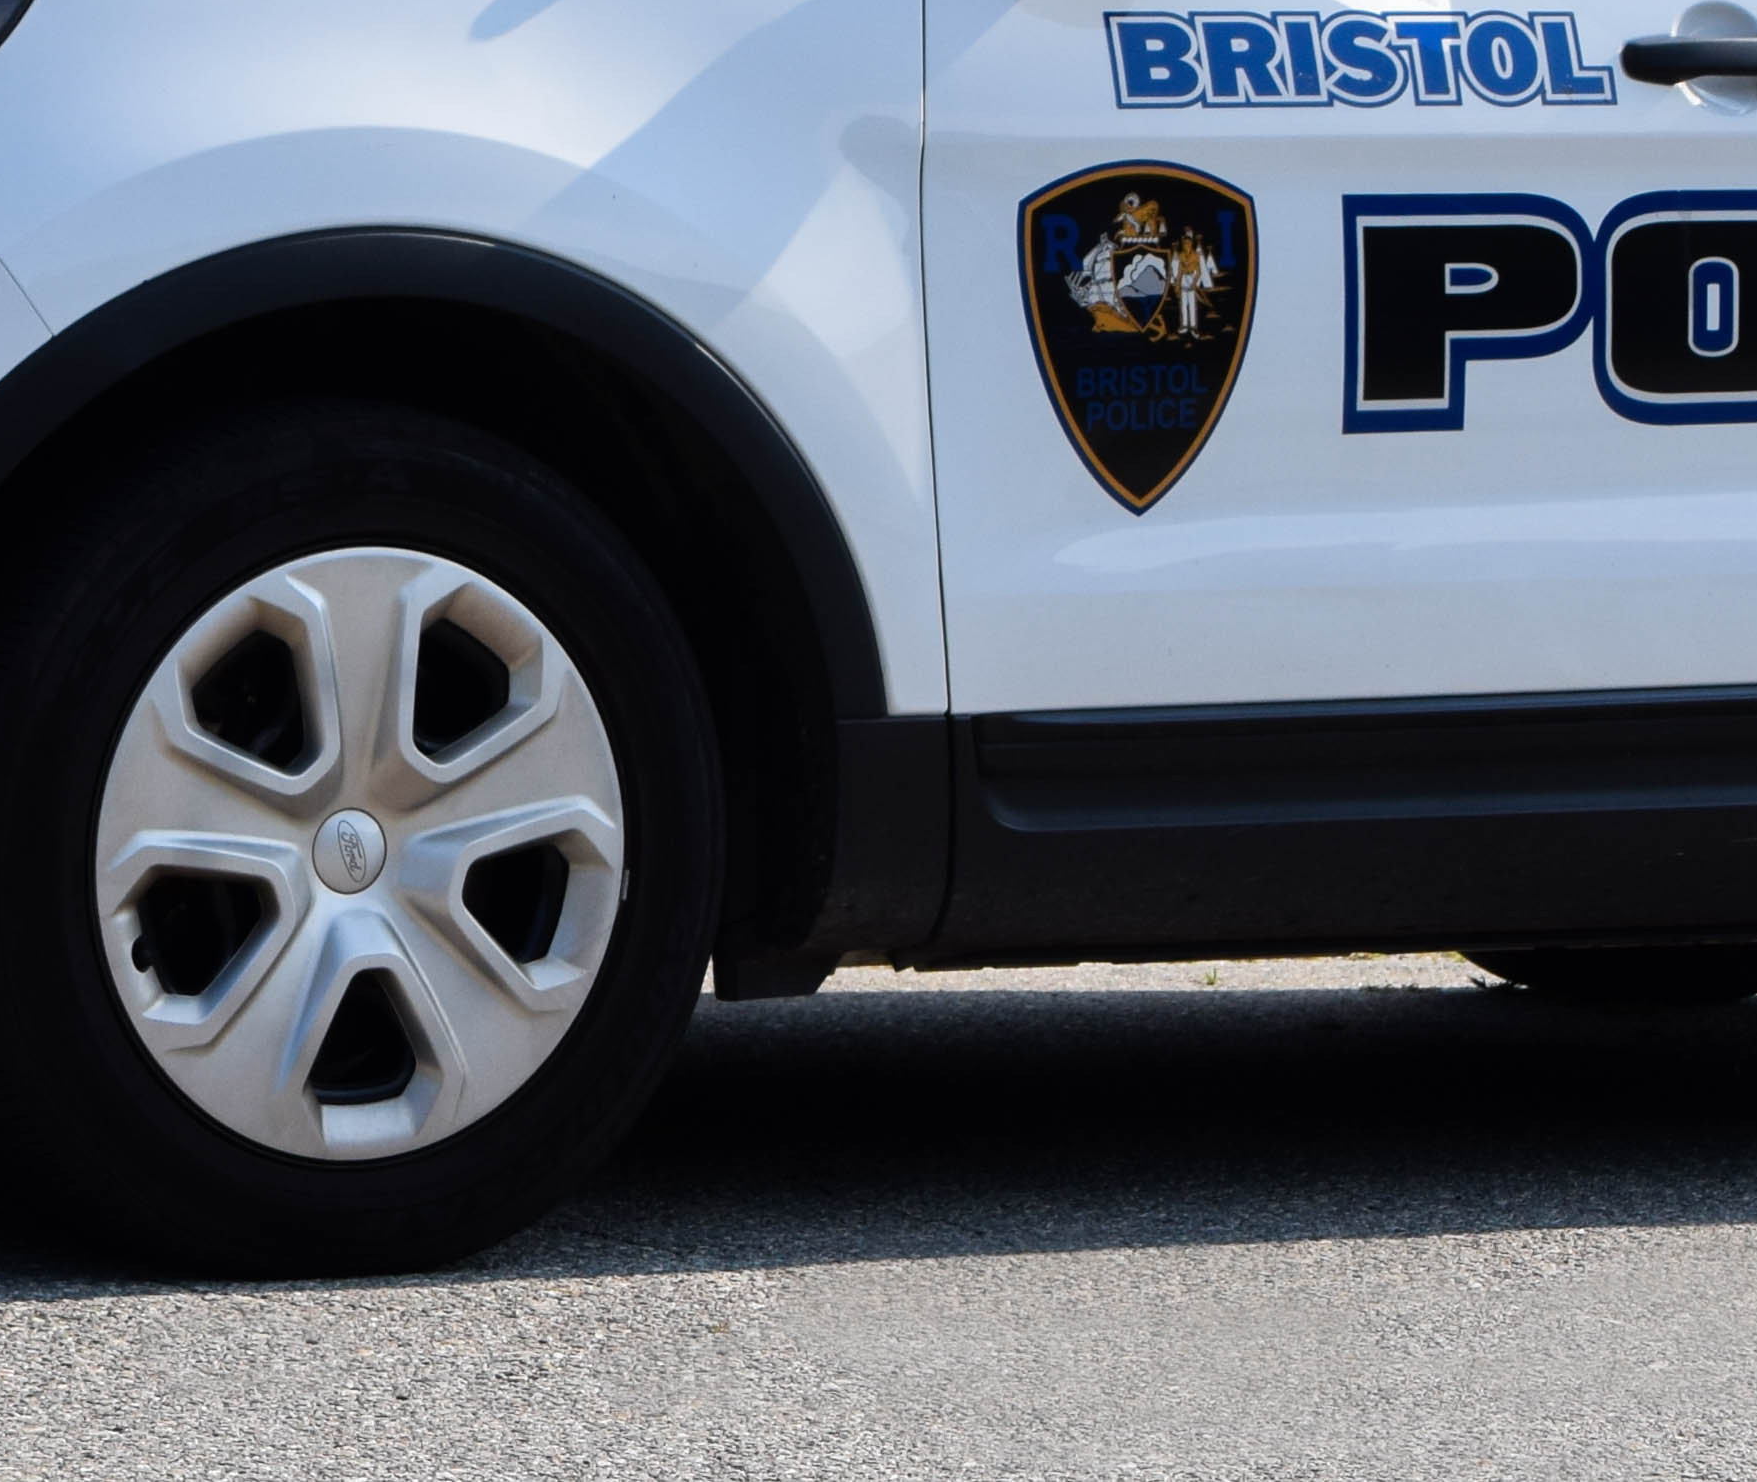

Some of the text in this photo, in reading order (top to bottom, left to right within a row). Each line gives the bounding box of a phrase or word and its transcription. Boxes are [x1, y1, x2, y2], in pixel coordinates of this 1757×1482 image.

[1103, 10, 1618, 109] BRISTOL
[1041, 213, 1083, 274] R
[1076, 363, 1209, 398] BRISTOL
[1087, 398, 1197, 432] POLICE
[340, 830, 362, 872] Ford
